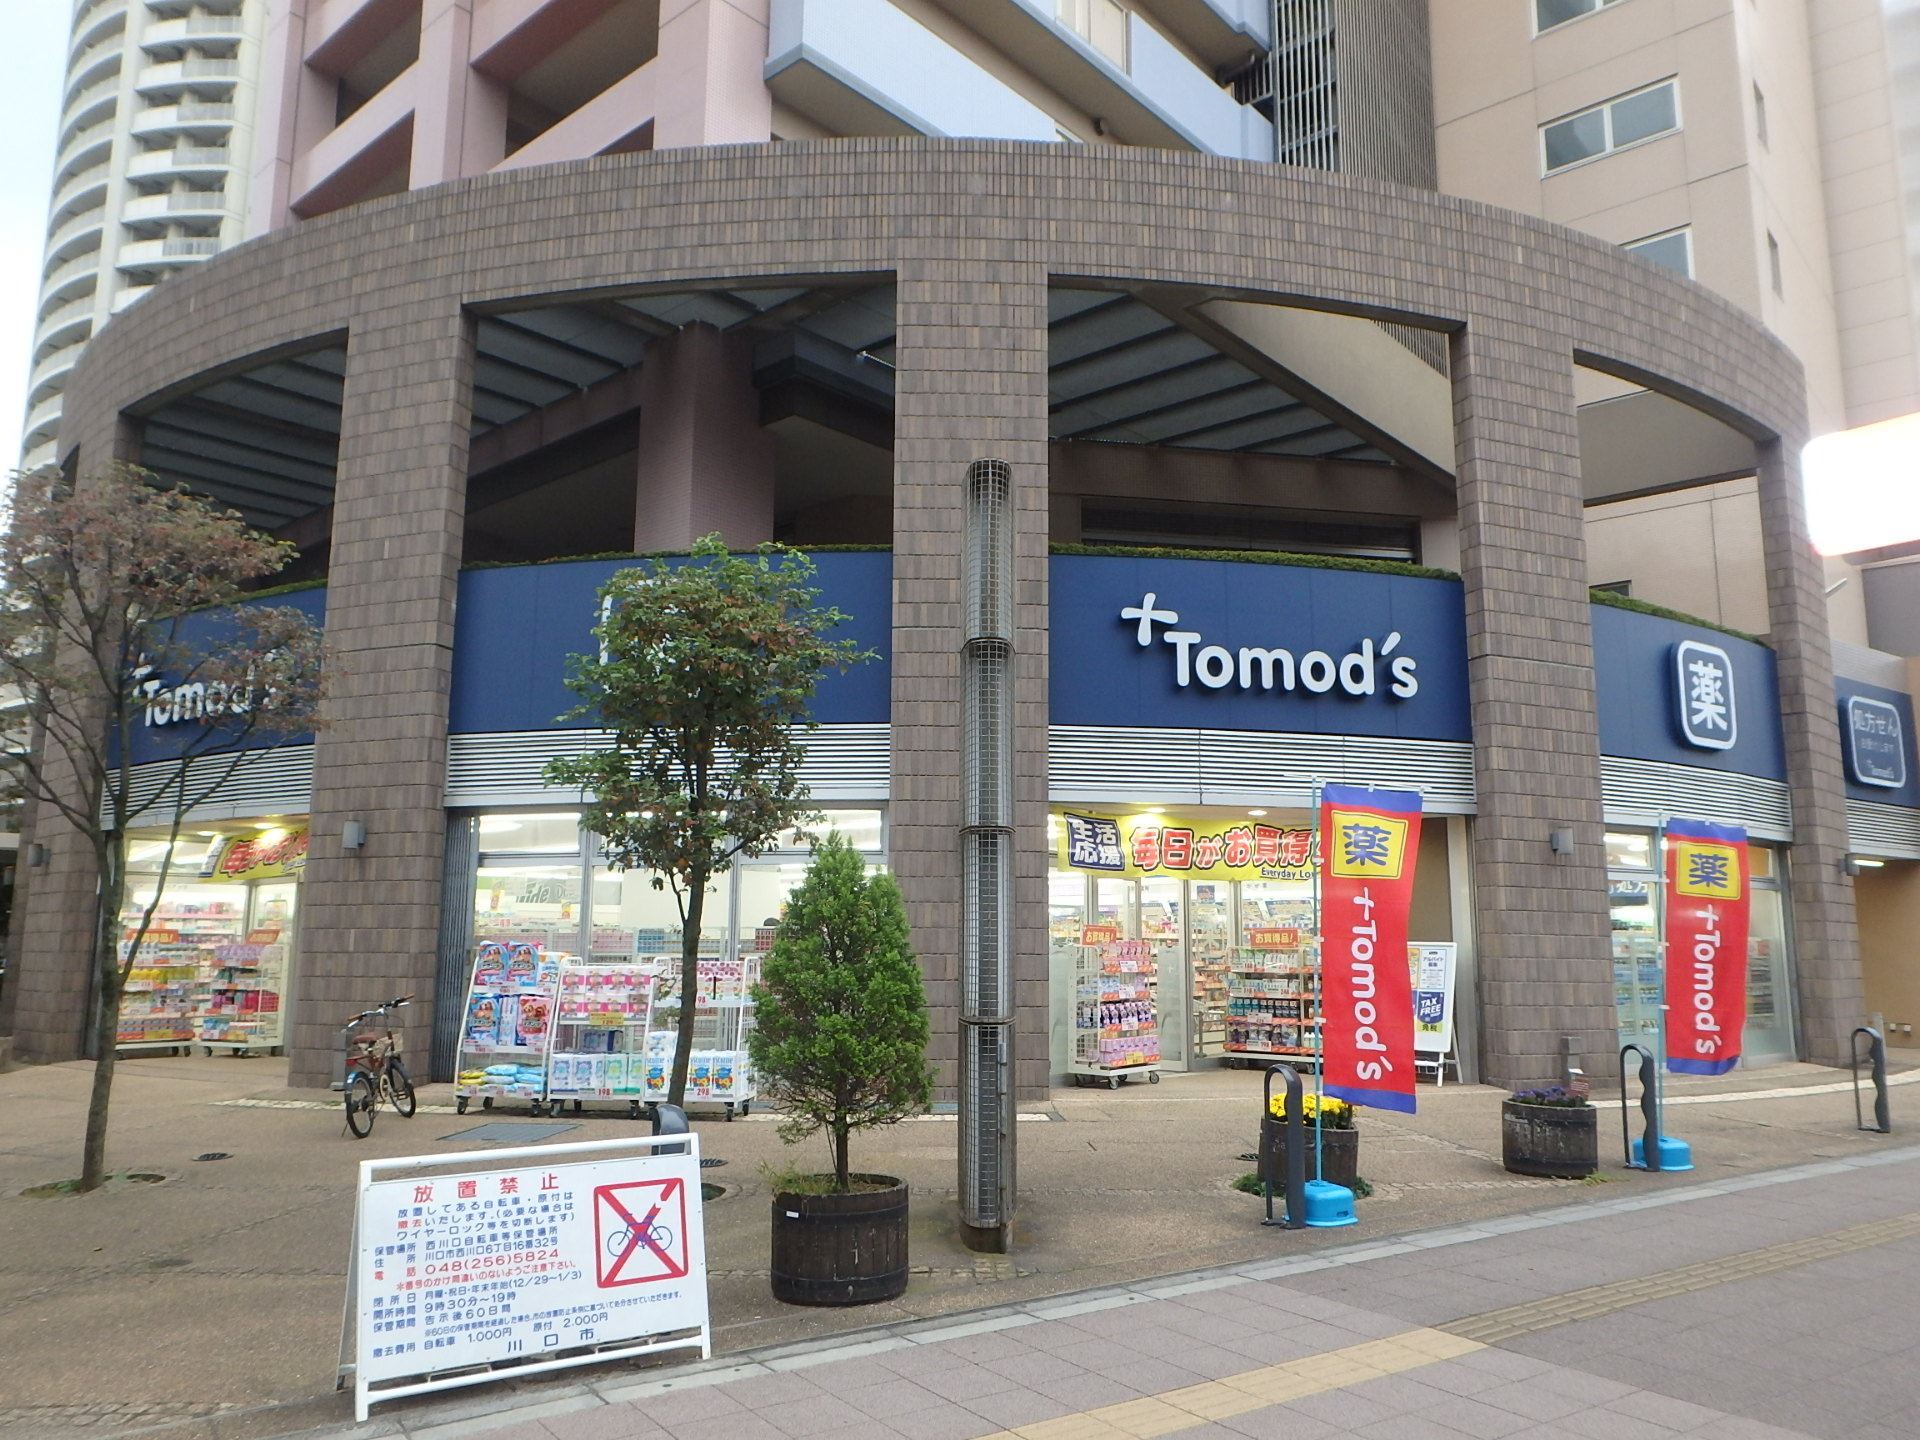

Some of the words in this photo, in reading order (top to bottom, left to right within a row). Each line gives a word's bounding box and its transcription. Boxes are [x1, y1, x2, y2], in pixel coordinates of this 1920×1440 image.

[1163, 631, 1419, 699] Tomod's
[1688, 660, 1728, 731] 薬
[1068, 818, 1116, 843] 生活
[1072, 841, 1122, 867] 応援
[1342, 823, 1392, 867] 薬
[1261, 867, 1296, 879] Everyday
[1688, 852, 1730, 889] 薬
[1351, 919, 1394, 1082] Tomod's
[1420, 997, 1437, 1008] TAX
[1693, 929, 1723, 1055] Tomod's
[1420, 1004, 1441, 1016] FREE
[413, 1173, 560, 1203] 放置禁止
[425, 1248, 560, 1276] 048(256)5824
[424, 1303, 512, 1326] 告示後60日間
[424, 1336, 456, 1351] 自転車
[507, 1327, 595, 1354] 川口市
